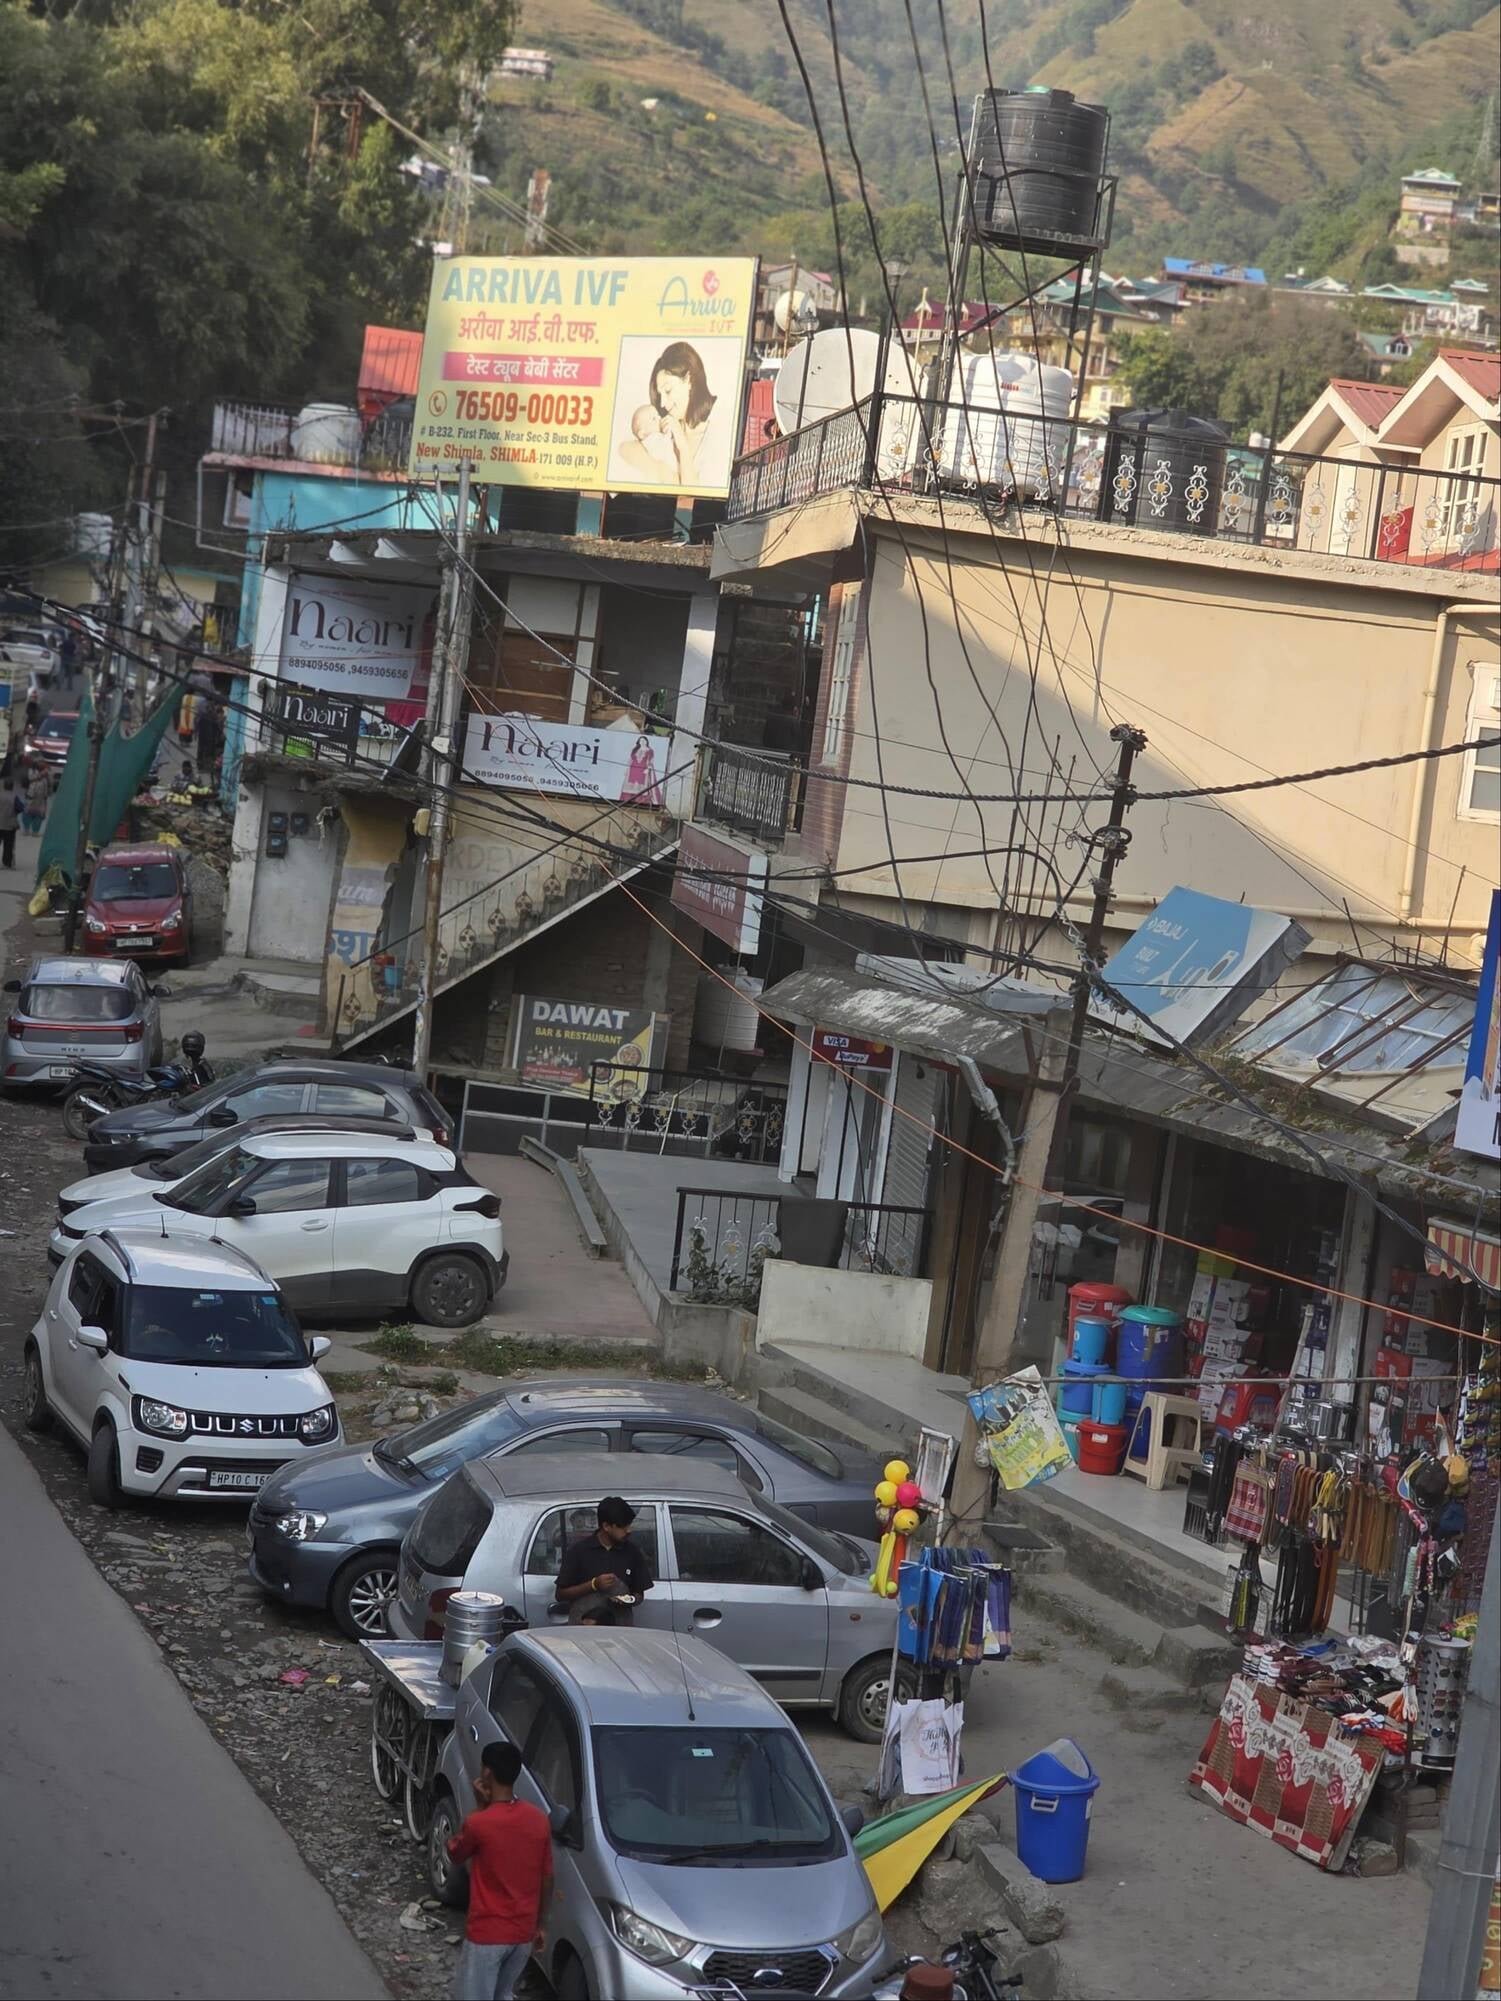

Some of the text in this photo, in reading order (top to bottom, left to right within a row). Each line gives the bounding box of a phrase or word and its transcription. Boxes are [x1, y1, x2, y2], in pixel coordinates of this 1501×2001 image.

[442, 266, 629, 306] ARRIVA IVF
[458, 311, 505, 341] अरीवा
[466, 353, 580, 382] टेस्ट ट्यूब बेबी सेंटर
[455, 390, 593, 426] 76509-00033
[457, 428, 478, 440] First
[504, 431, 524, 442] Near
[552, 432, 568, 444] Bus
[416, 442, 440, 457] New
[288, 657, 346, 673] 8894095056
[532, 1001, 630, 1030] DAWAT
[535, 1027, 623, 1044] BAR & RESTAURANT
[244, 1475, 251, 1485] C
